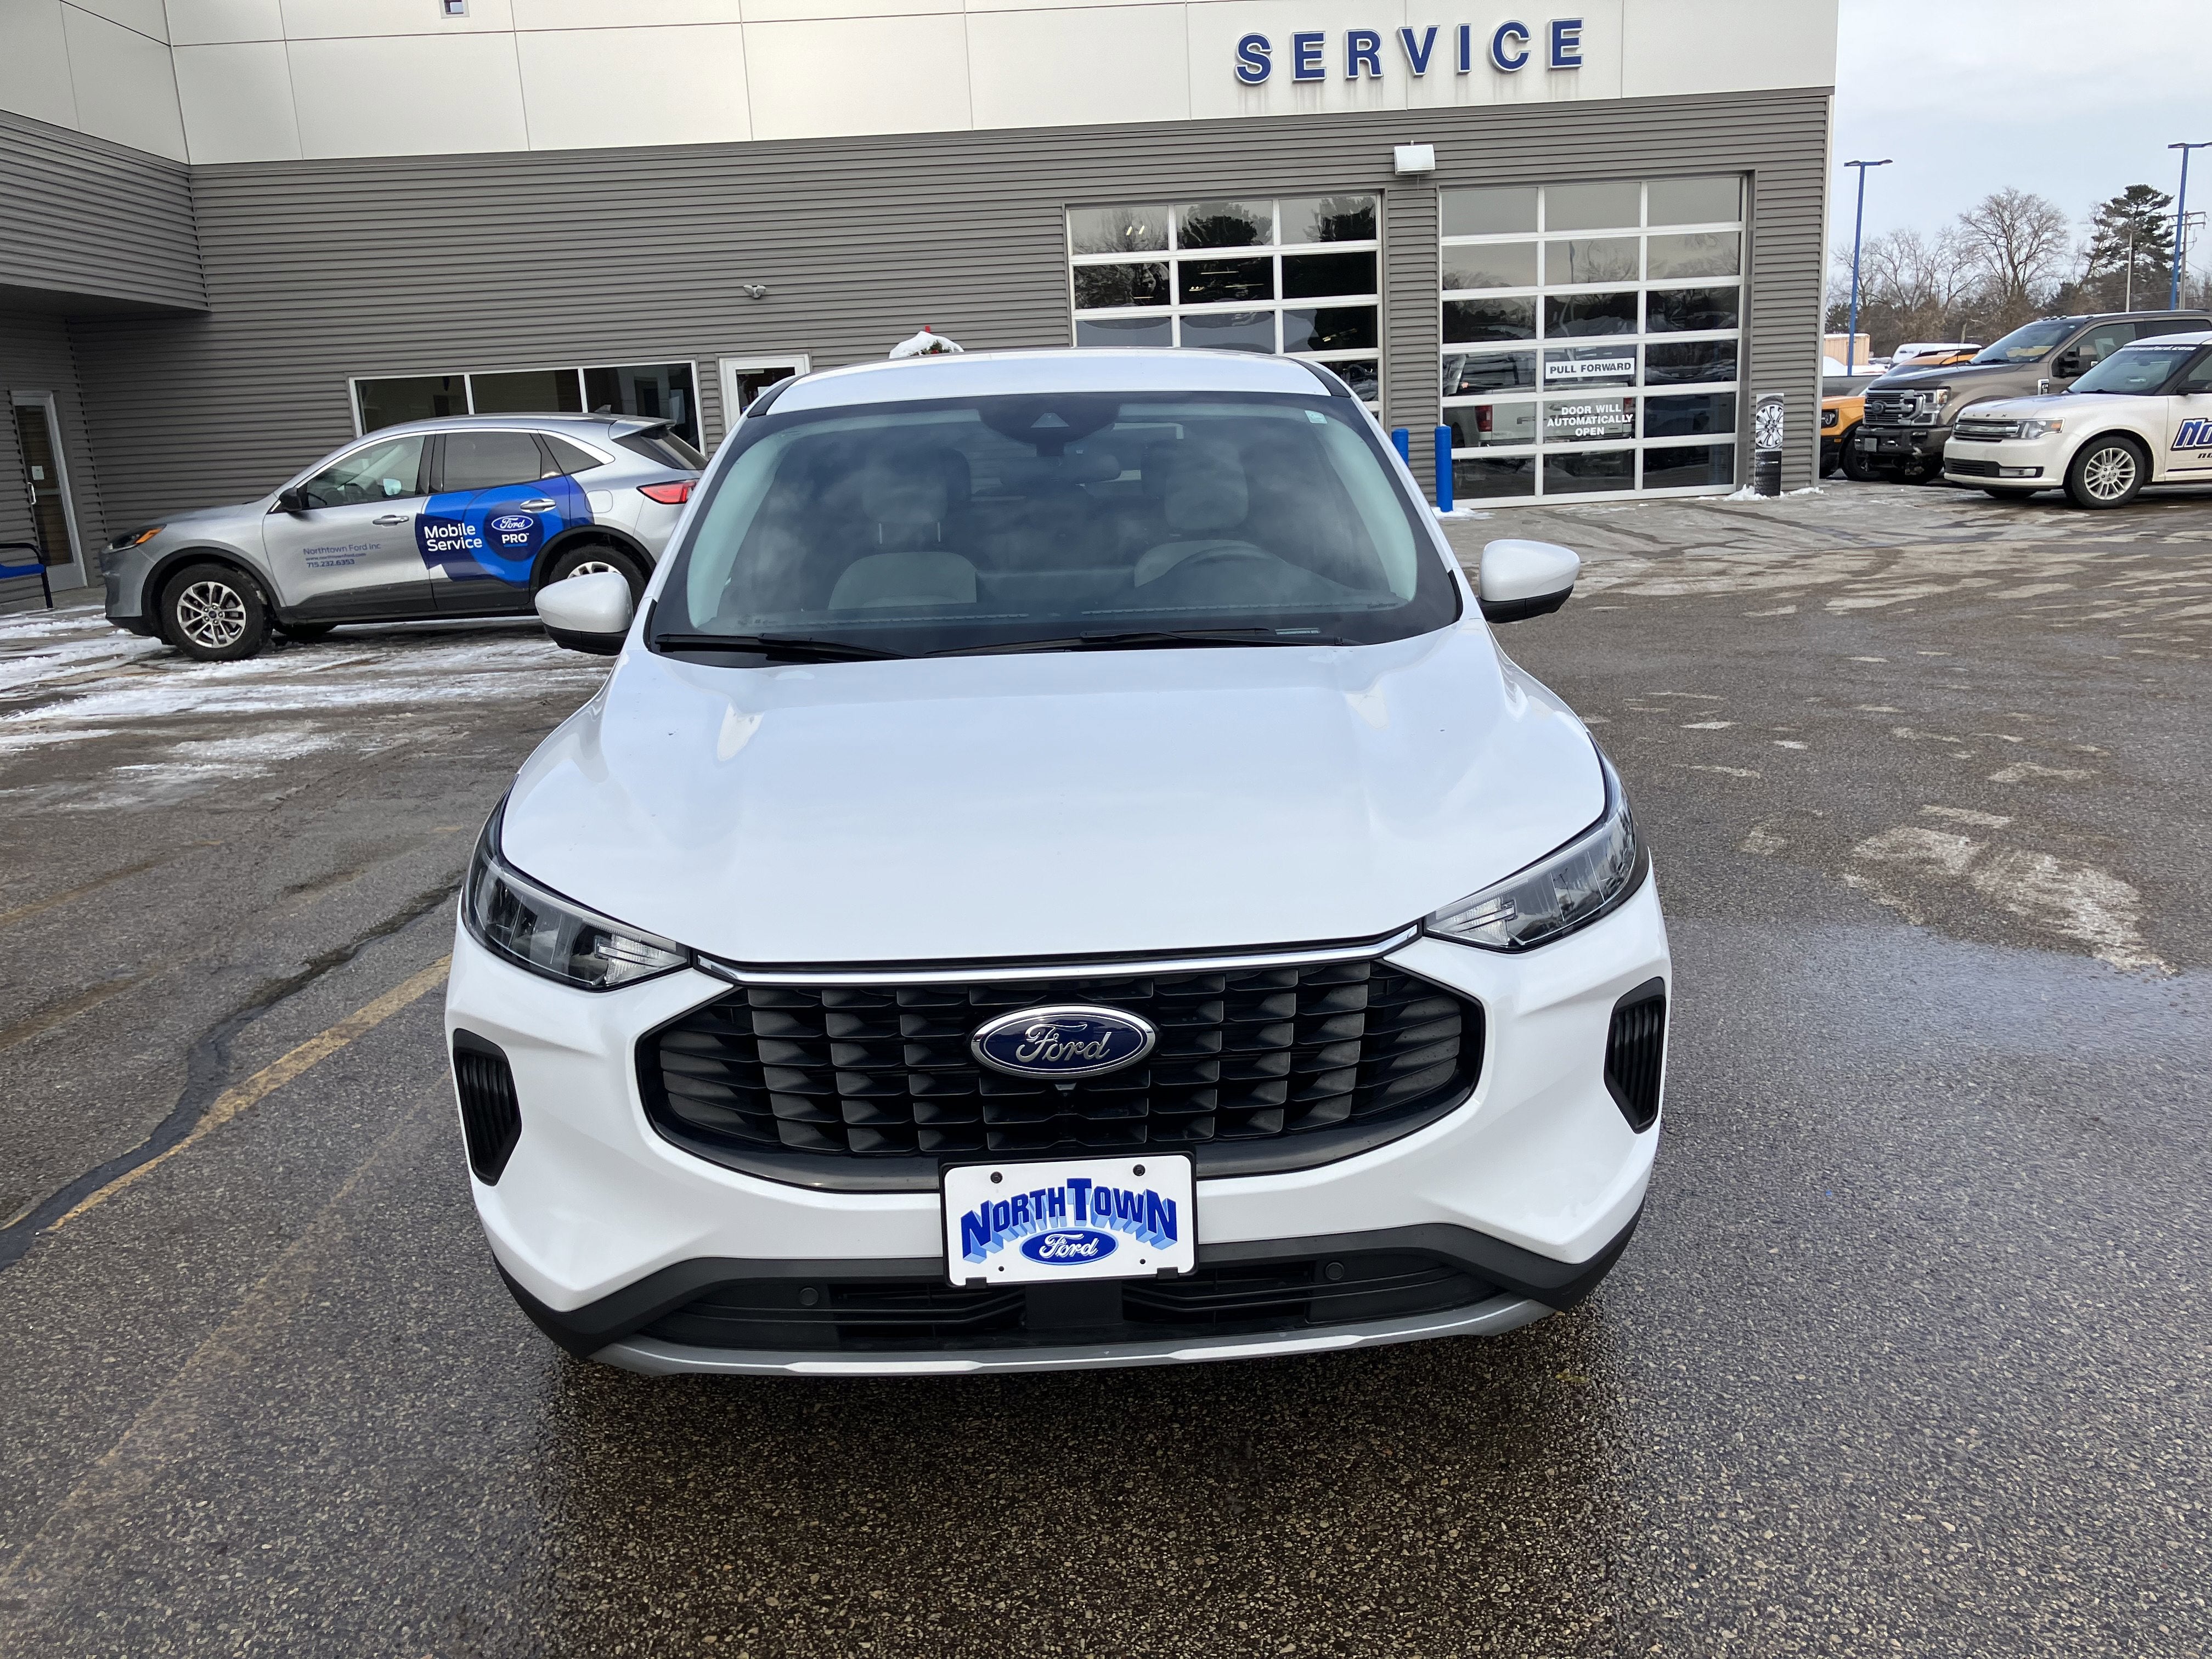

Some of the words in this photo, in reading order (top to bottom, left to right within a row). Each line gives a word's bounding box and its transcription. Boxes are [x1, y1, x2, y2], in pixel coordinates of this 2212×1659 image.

[1235, 18, 1584, 86] SERVICE
[1550, 365, 1576, 374] PULL
[1581, 363, 1631, 372] FORWARD
[1561, 406, 1592, 415] DOOR
[1596, 404, 1622, 413] WILL
[1547, 414, 1633, 427] AUTOMATICALLY
[1575, 427, 1605, 436] OPEN
[424, 523, 476, 539] Mobile
[303, 546, 348, 555] Northtown
[427, 537, 483, 551] Service
[307, 559, 355, 567] 715.232.6353
[1015, 1023, 1112, 1063] Ford
[1039, 1233, 1099, 1259] Ford
